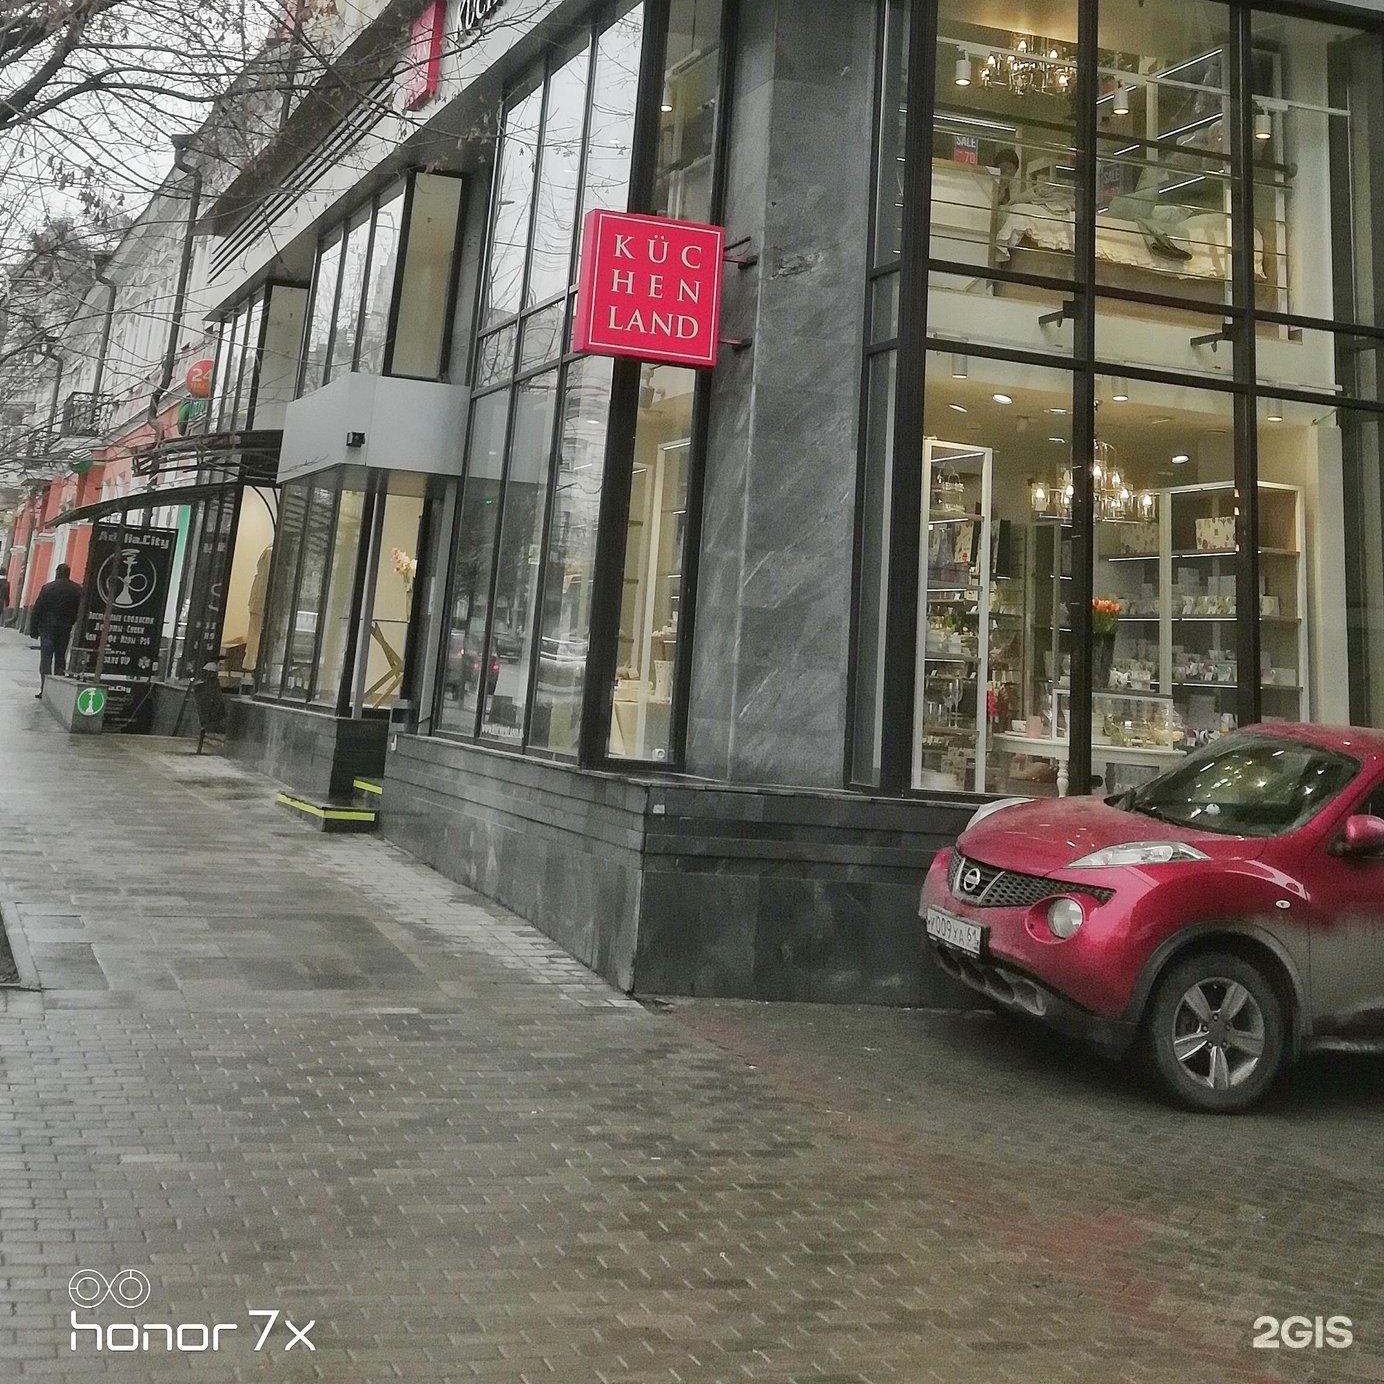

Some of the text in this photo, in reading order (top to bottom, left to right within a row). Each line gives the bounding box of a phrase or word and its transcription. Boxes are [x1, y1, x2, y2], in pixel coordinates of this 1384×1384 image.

[956, 136, 976, 148] SALE
[613, 233, 702, 269] KÜC
[610, 268, 701, 304] HEN
[607, 305, 699, 339] LAND
